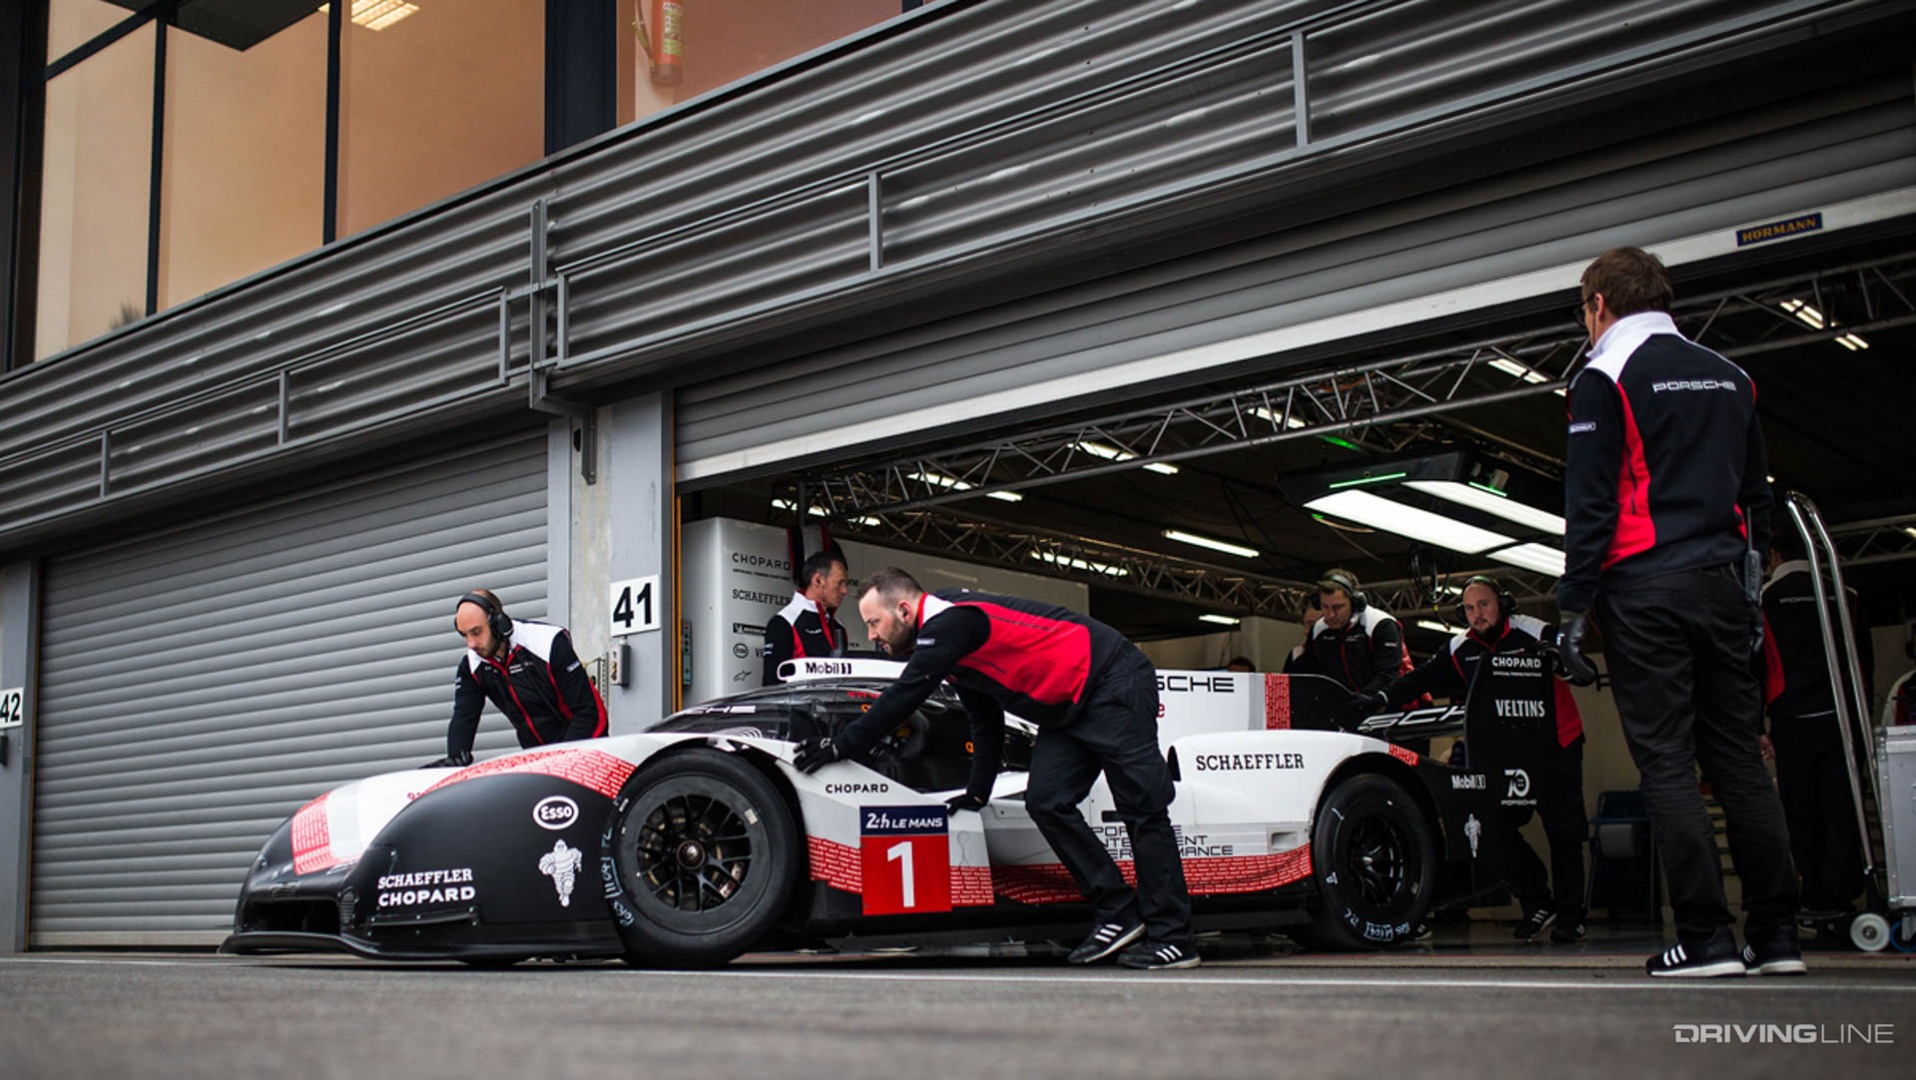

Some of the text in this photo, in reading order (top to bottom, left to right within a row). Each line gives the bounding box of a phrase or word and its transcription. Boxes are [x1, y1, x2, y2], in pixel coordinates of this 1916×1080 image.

[1652, 380, 1737, 393] PORSCHE
[732, 552, 791, 571] CHOPARD
[612, 582, 652, 628] 41
[805, 662, 839, 674] Mobil
[1491, 656, 1541, 668] CHOPARD
[1156, 676, 1235, 692] SCHE
[0, 692, 21, 723] 42
[1496, 699, 1545, 717] VELTINS
[1196, 754, 1304, 771] SCHAEFFLER
[826, 784, 889, 794] CHOPARD
[1451, 774, 1476, 789] Mobil
[540, 804, 572, 821] Esso
[891, 818, 907, 829] LE
[908, 817, 943, 829] MANS
[378, 868, 473, 889] SCHAEFFLER
[887, 841, 916, 907] 1
[378, 886, 476, 907] CHOPARD
